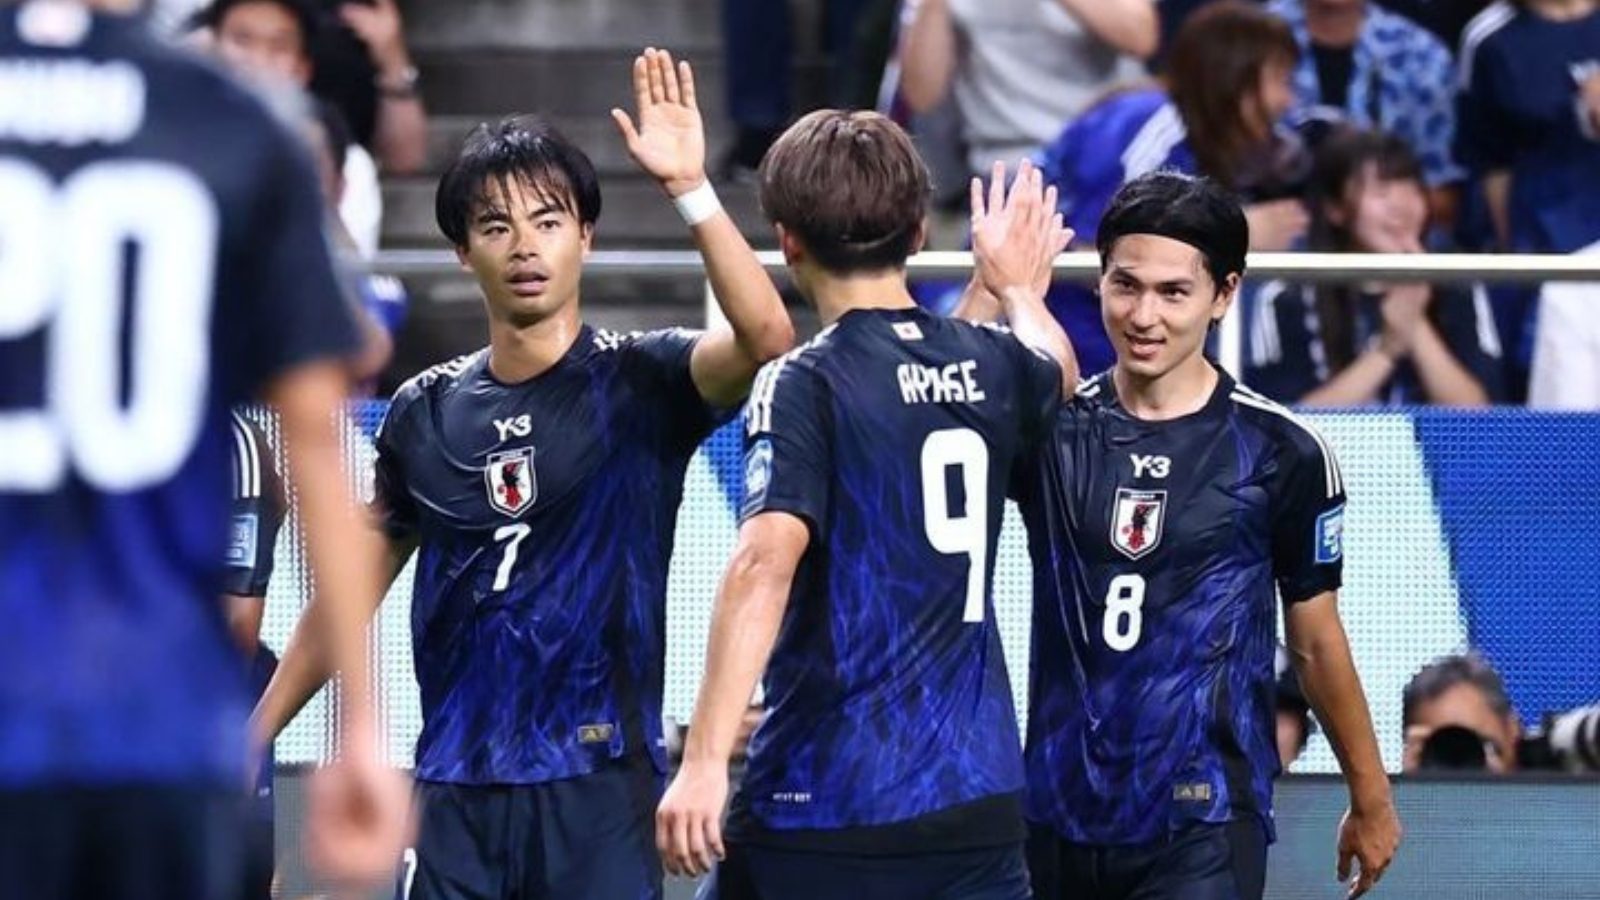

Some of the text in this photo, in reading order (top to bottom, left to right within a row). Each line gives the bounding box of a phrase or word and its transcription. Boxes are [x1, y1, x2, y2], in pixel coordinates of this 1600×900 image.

[1131, 453, 1171, 478] Y-3
[493, 522, 532, 591] 7
[921, 427, 989, 622] 9
[1103, 573, 1146, 651] 8
